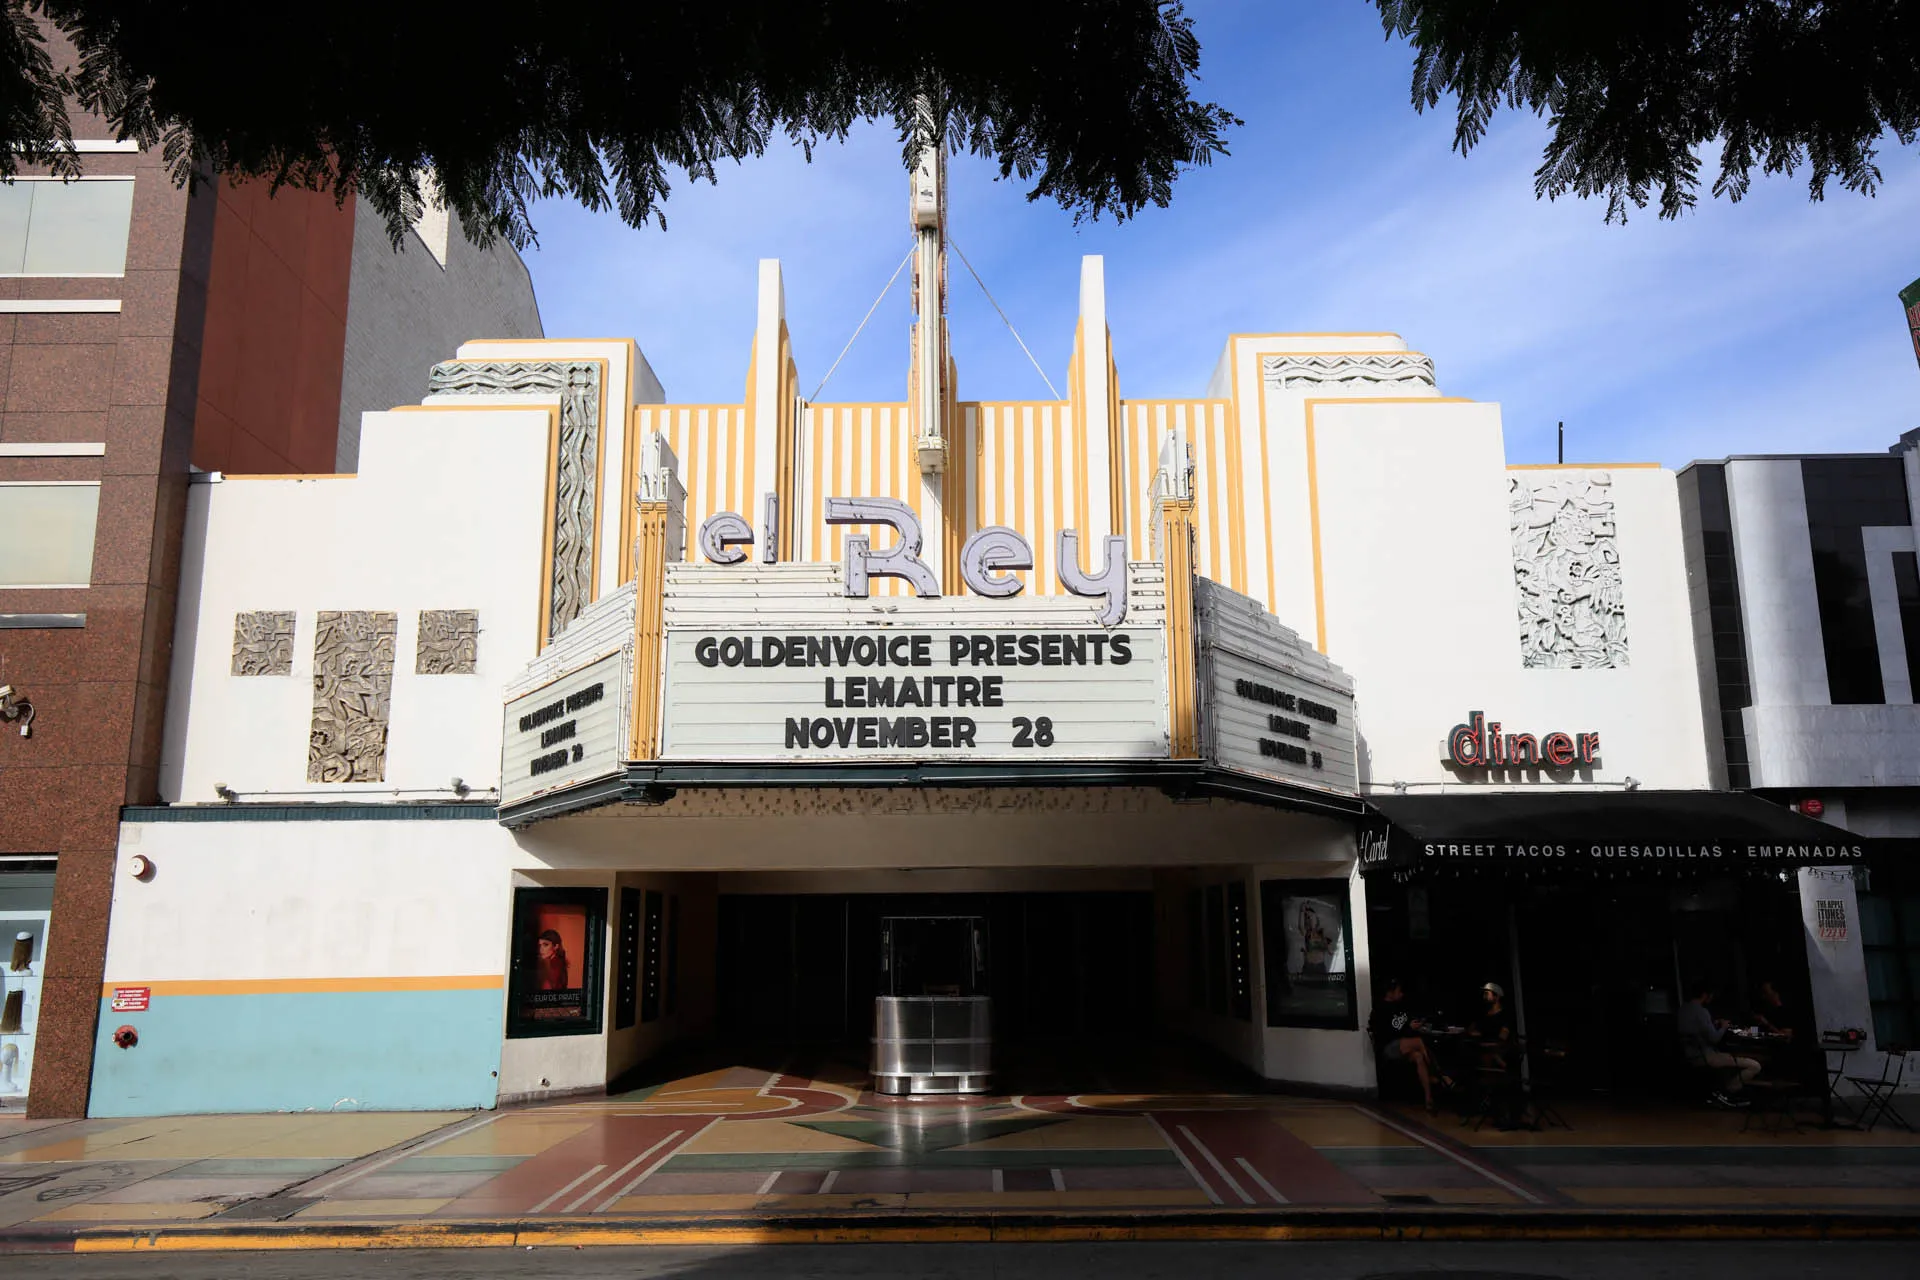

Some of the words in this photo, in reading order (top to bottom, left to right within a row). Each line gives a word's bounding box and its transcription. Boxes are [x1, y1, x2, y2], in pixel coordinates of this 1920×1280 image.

[699, 491, 779, 564] el
[825, 496, 1129, 626] Rey
[695, 635, 931, 668] GOLDENVOICE
[950, 634, 1133, 666] PRESENTS
[825, 676, 1003, 708] LEMAITRE
[785, 717, 977, 749] NOVEMBER
[1012, 716, 1055, 748] 28
[1448, 710, 1600, 767] diner
[1424, 844, 1496, 857] STREET
[1504, 845, 1567, 857] TACOS
[1590, 845, 1724, 859] QUESADILLAS
[1747, 845, 1863, 858] EMPANADAS
